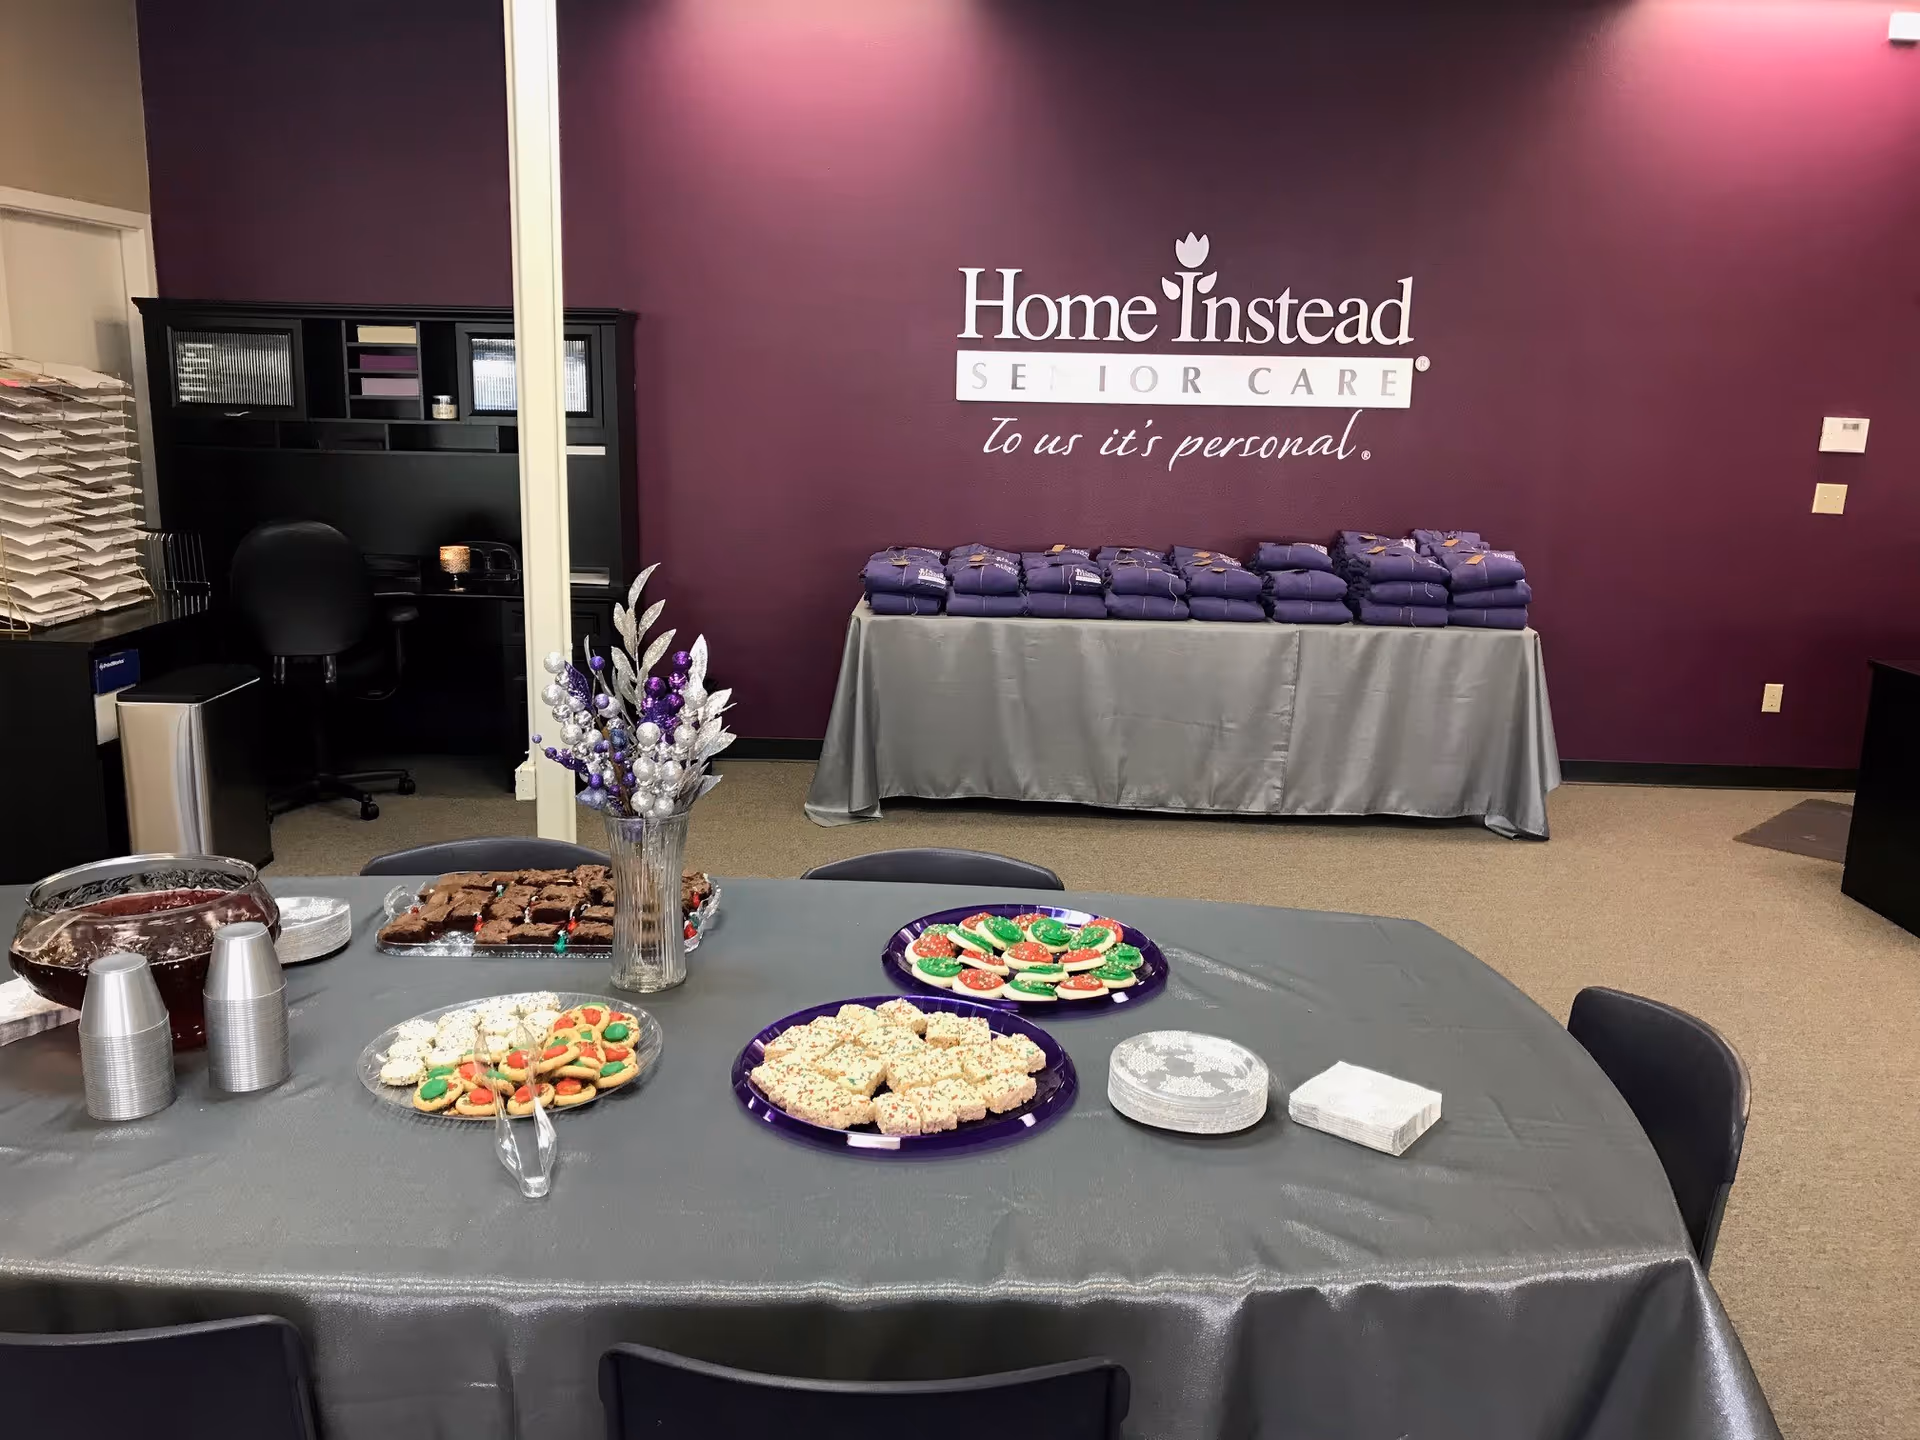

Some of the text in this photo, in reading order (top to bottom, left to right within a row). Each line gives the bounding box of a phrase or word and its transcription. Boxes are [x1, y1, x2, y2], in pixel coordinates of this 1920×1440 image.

[957, 267, 1415, 346] Home Instead
[971, 361, 1202, 395] SEIOR
[982, 416, 1022, 455] To
[1033, 432, 1083, 456] us
[1100, 418, 1163, 458] it's
